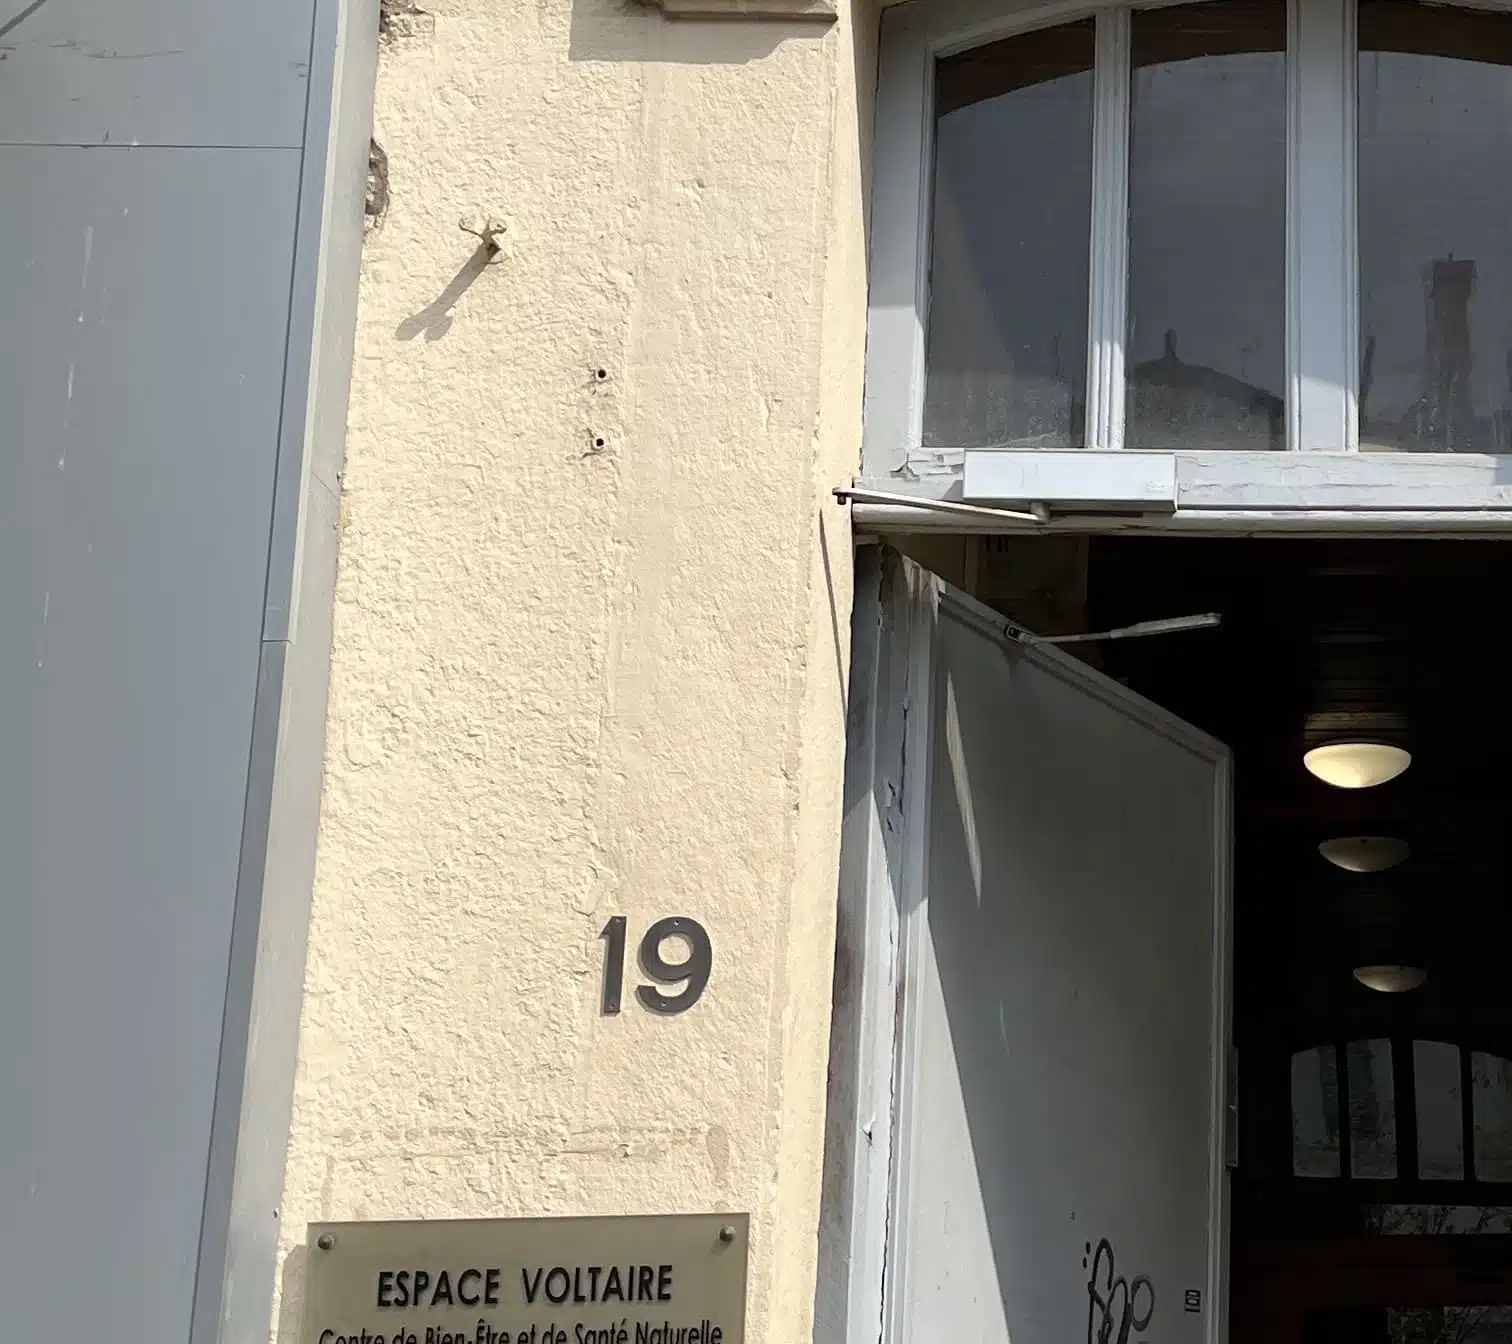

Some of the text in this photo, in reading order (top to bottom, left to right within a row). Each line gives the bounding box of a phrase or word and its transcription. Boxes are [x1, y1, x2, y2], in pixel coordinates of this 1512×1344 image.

[598, 915, 713, 1017] 19
[378, 1264, 673, 1308] ESPACE VOLTAIRE
